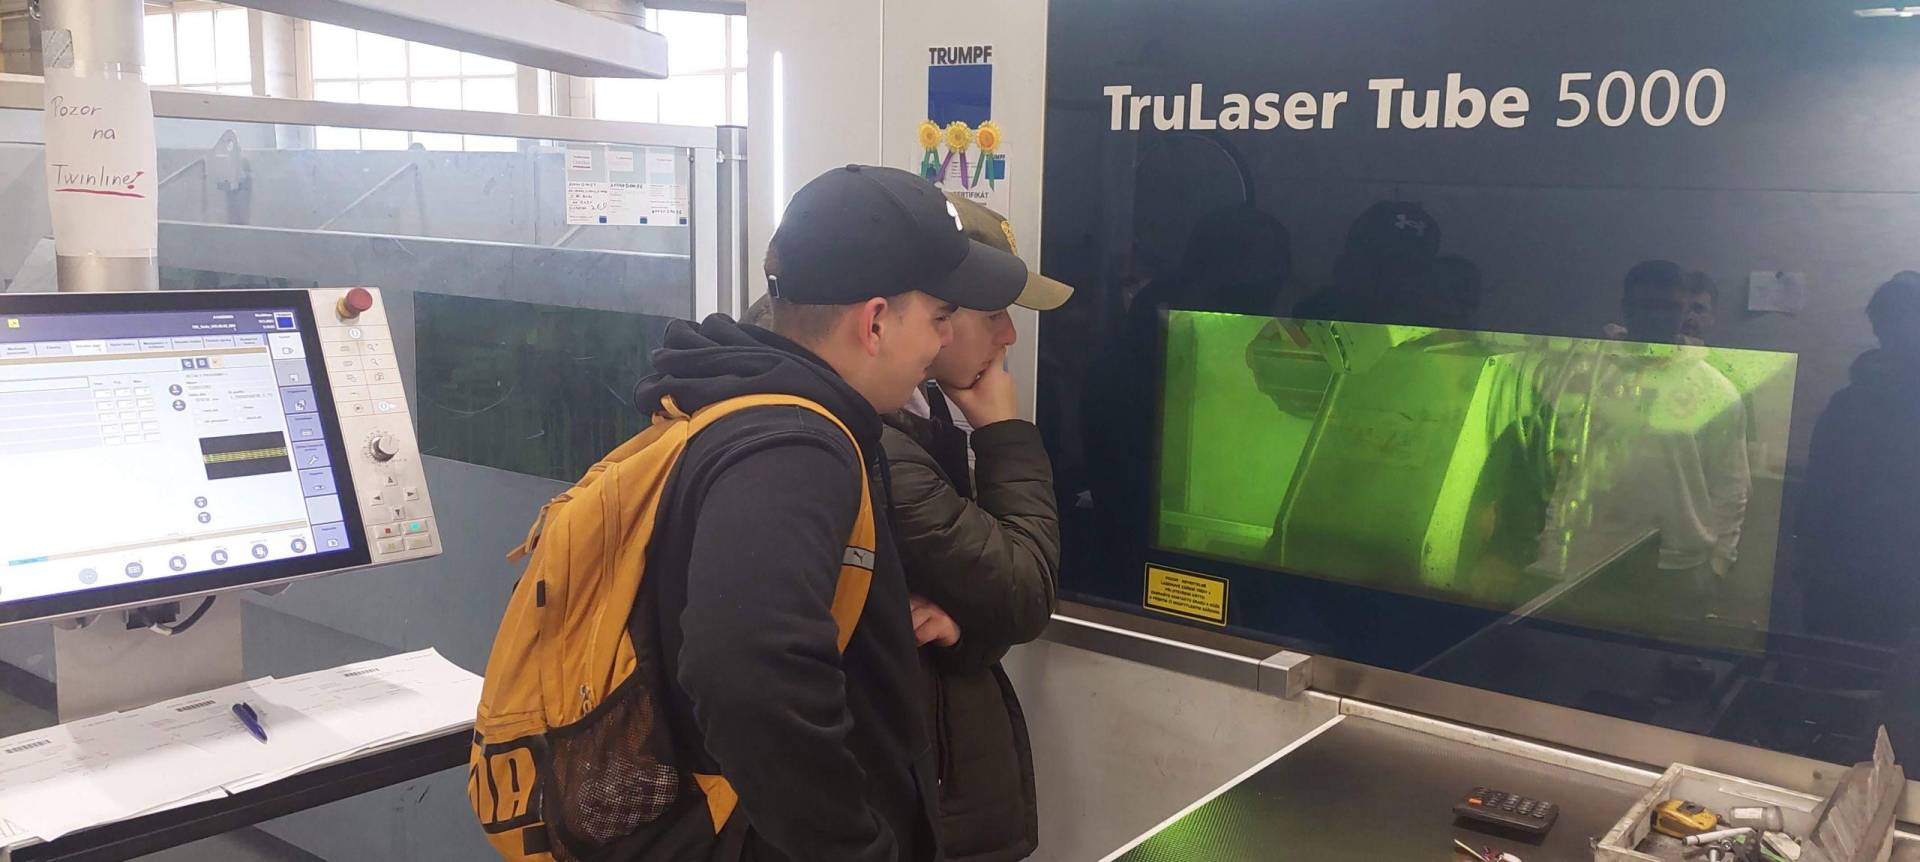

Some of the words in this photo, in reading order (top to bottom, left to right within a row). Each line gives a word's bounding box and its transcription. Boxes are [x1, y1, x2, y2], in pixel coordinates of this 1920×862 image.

[929, 46, 992, 64] TRUMPF
[51, 95, 102, 117] Pozor
[1104, 83, 1348, 130] TruLaser
[1368, 72, 1529, 128] Tube
[1556, 68, 1726, 128] 5000
[92, 128, 116, 140] na
[51, 164, 144, 190] Twinline!
